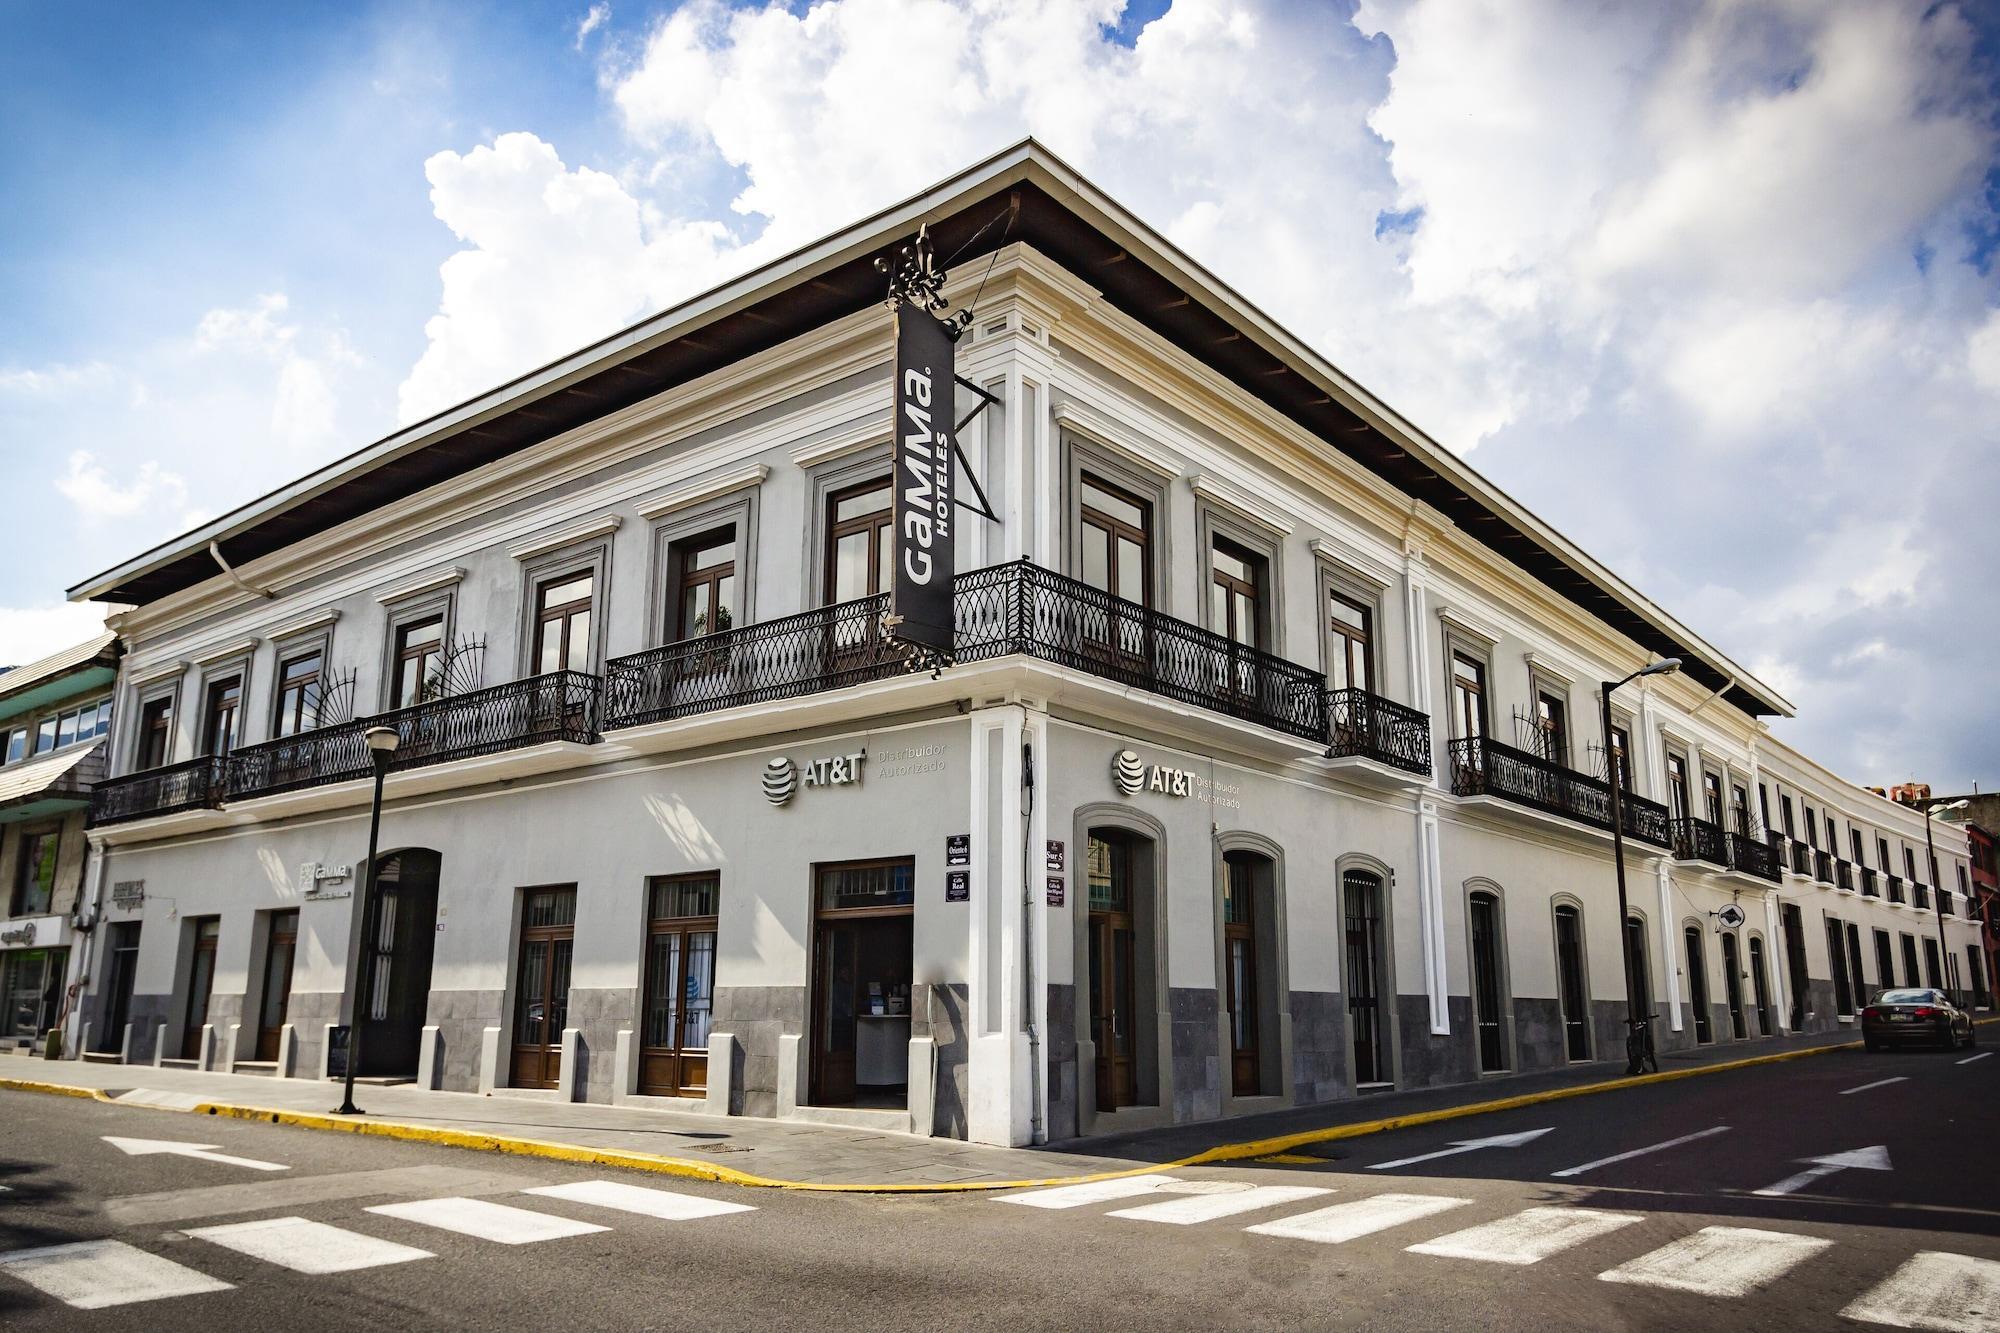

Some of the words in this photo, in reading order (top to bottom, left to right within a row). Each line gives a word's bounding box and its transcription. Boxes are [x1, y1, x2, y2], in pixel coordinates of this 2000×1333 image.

[936, 431, 949, 538] HOTELES
[878, 744, 946, 763] Distribuidor
[801, 753, 864, 787] AT&T
[879, 760, 946, 779] Autorizado
[1149, 765, 1196, 797] AT&T
[1196, 776, 1240, 795] Distribuidor
[1197, 791, 1240, 809] Autorizado
[1046, 850, 1058, 860] Sur
[1058, 852, 1063, 861] 5
[952, 882, 965, 890] Real
